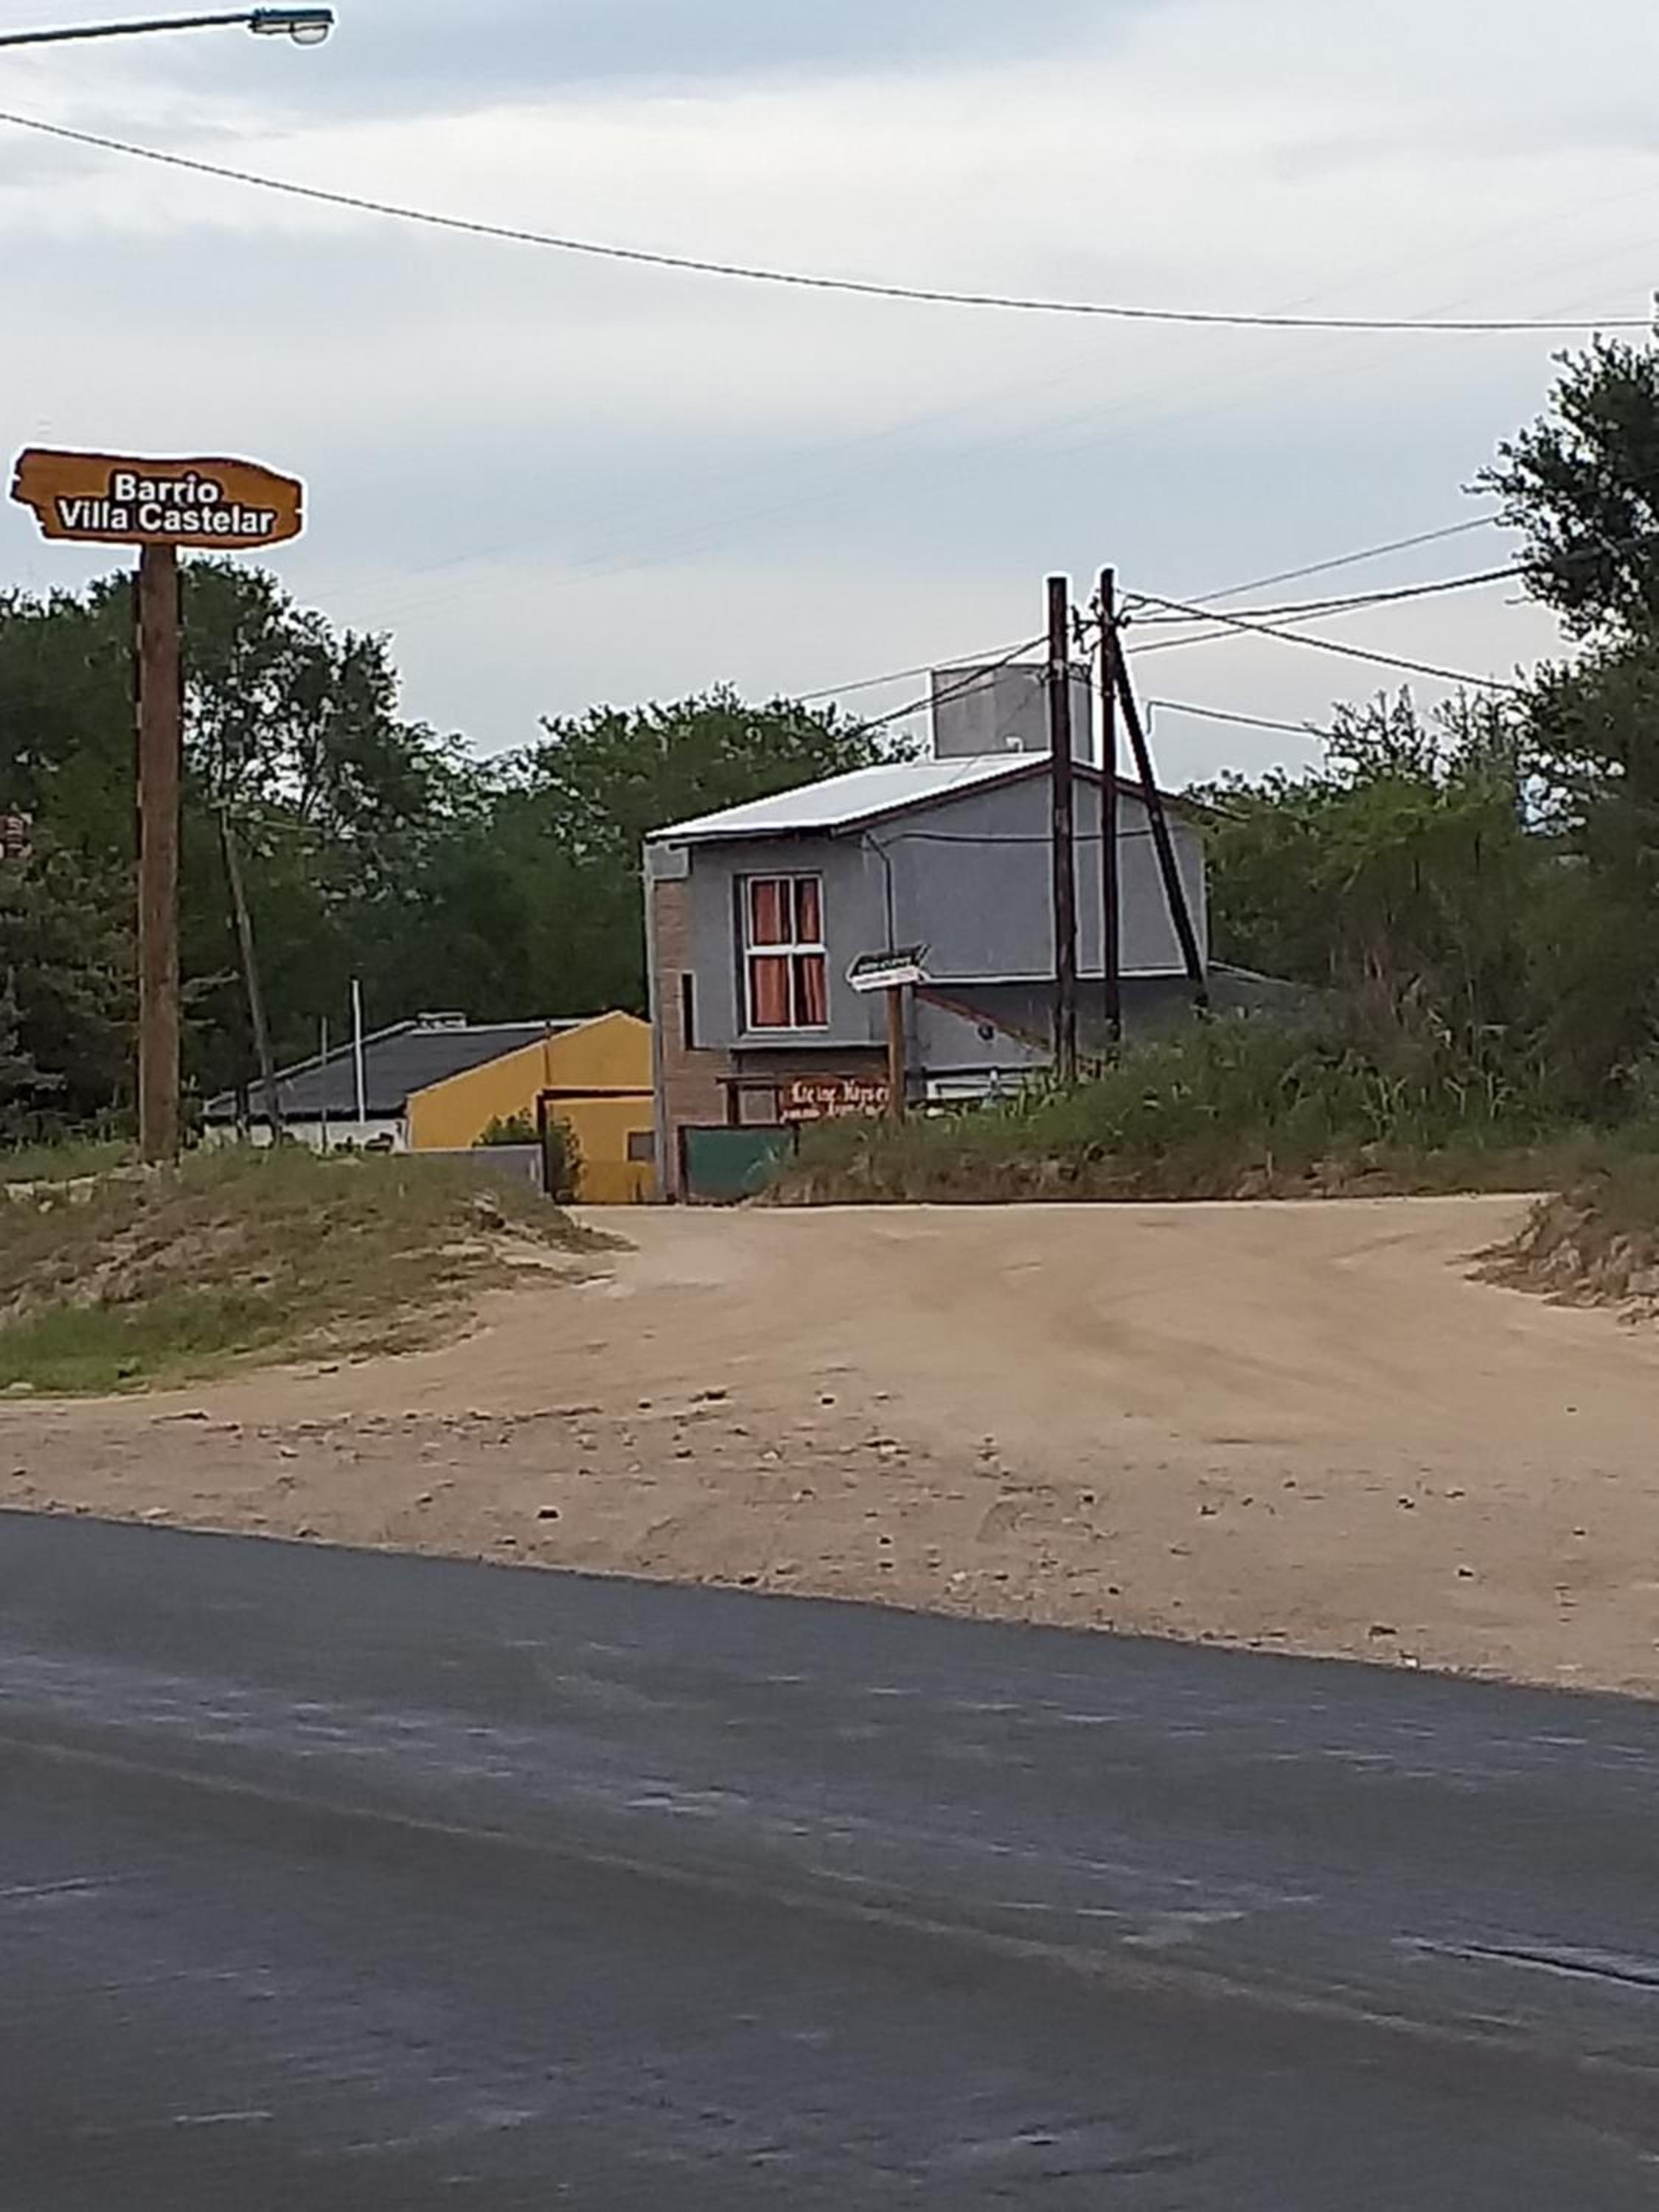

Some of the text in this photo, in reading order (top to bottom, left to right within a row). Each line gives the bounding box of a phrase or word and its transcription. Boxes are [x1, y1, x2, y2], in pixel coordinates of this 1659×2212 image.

[115, 473, 218, 503] Barrio
[58, 499, 274, 534] Villa Castelar
